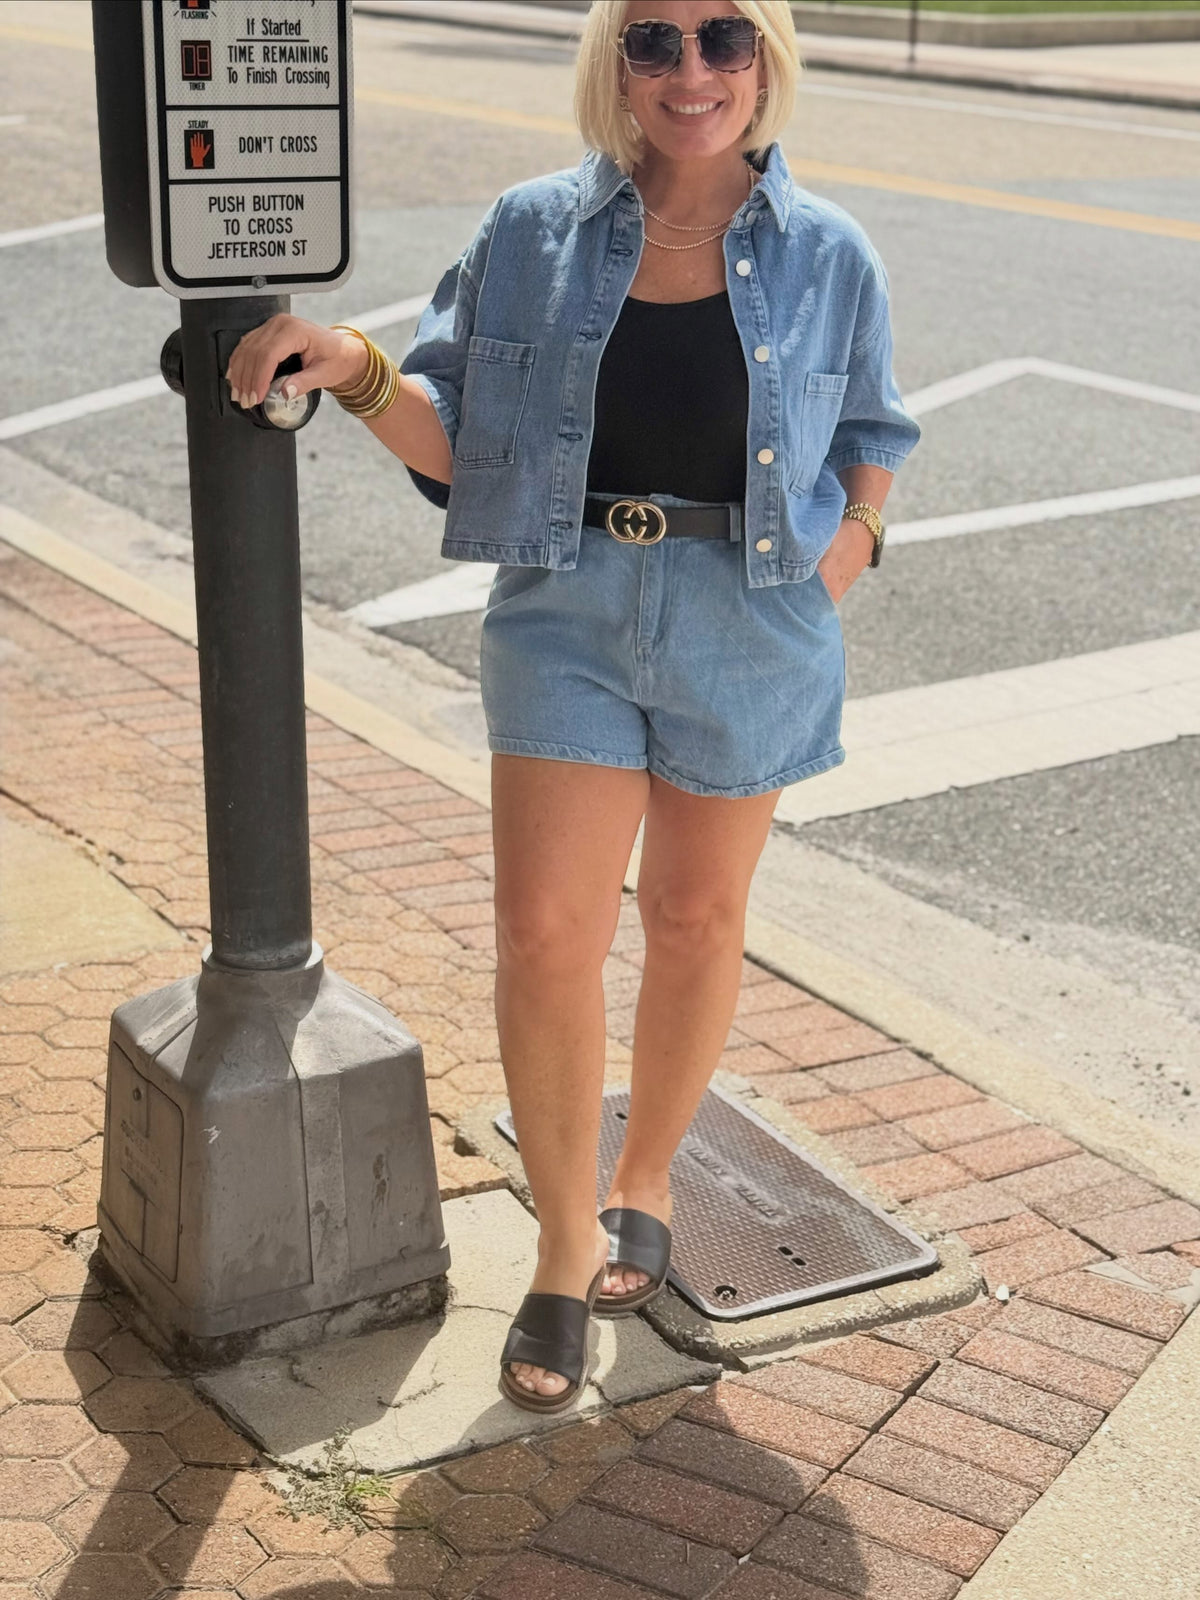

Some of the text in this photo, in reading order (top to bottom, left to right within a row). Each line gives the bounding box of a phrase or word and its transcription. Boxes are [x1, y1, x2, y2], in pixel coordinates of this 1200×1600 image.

[181, 11, 209, 20] FLASHING
[246, 18, 301, 35] If Started
[227, 46, 329, 63] TIME REMAINING
[189, 82, 205, 91] TIMER
[227, 67, 330, 89] To Finish Crossing
[187, 120, 209, 129] STEADY
[238, 136, 318, 154] DON'T CROSS
[208, 194, 304, 213] PUSH BUTTON
[223, 217, 293, 235] TO CROSS
[207, 239, 308, 260] JEFFERSON ST
